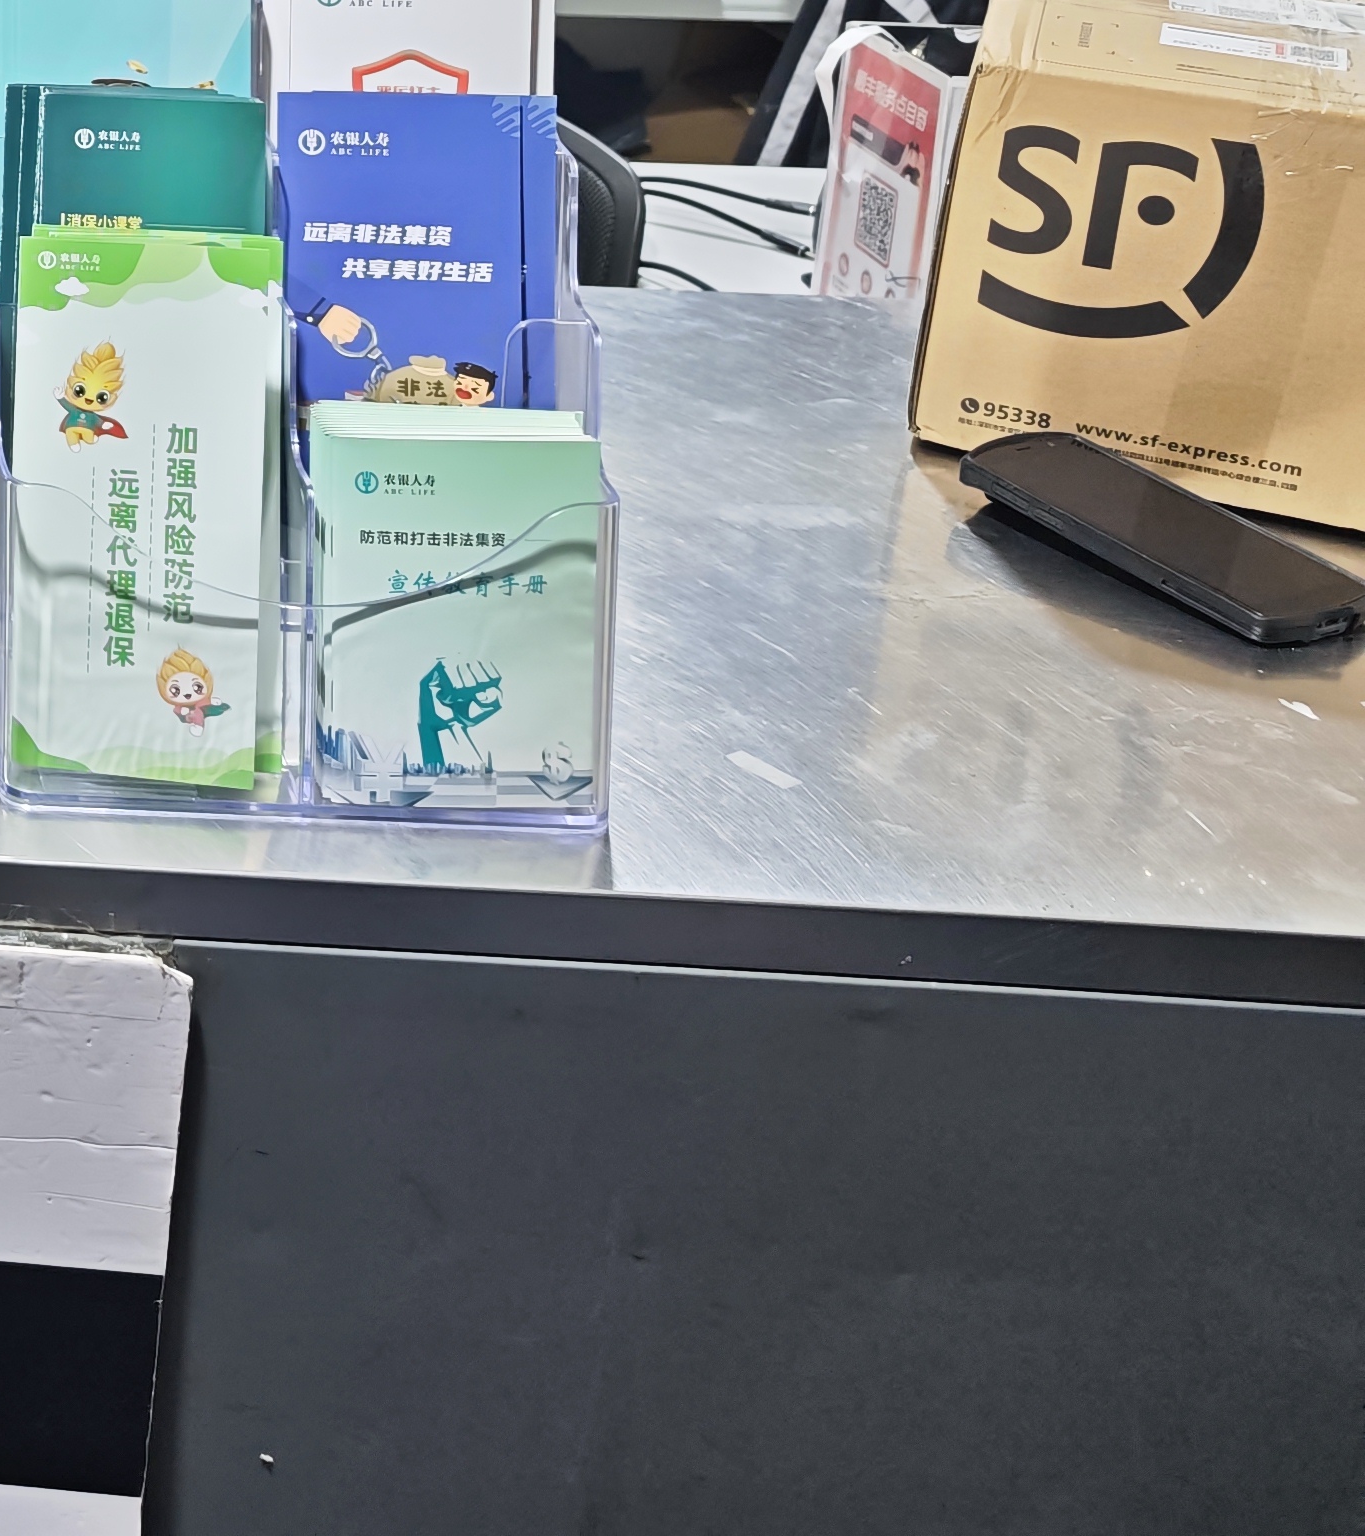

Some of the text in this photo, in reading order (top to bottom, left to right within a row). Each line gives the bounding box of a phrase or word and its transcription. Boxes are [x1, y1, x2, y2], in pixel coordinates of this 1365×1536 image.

[349, 0, 413, 8] ABC LIFE
[98, 129, 141, 143] 农银人寿
[330, 131, 390, 147] 农银人寿
[98, 142, 141, 151] ABC LIFE
[330, 147, 390, 157] ABC LIFE
[986, 124, 1200, 270] SF
[66, 213, 143, 231] 消保小课堂
[303, 222, 452, 247] 远离非法集资
[341, 258, 494, 283] 共享美好生活
[396, 377, 448, 399] 非法
[982, 401, 1303, 478] 95338 www.sf-express.com
[383, 473, 436, 488] 农银人寿
[383, 488, 436, 496] ABC LIFE
[163, 423, 199, 625] 加强风险防范
[359, 529, 506, 548] 防范和打击非法集资
[103, 469, 139, 668] 远离代理退保
